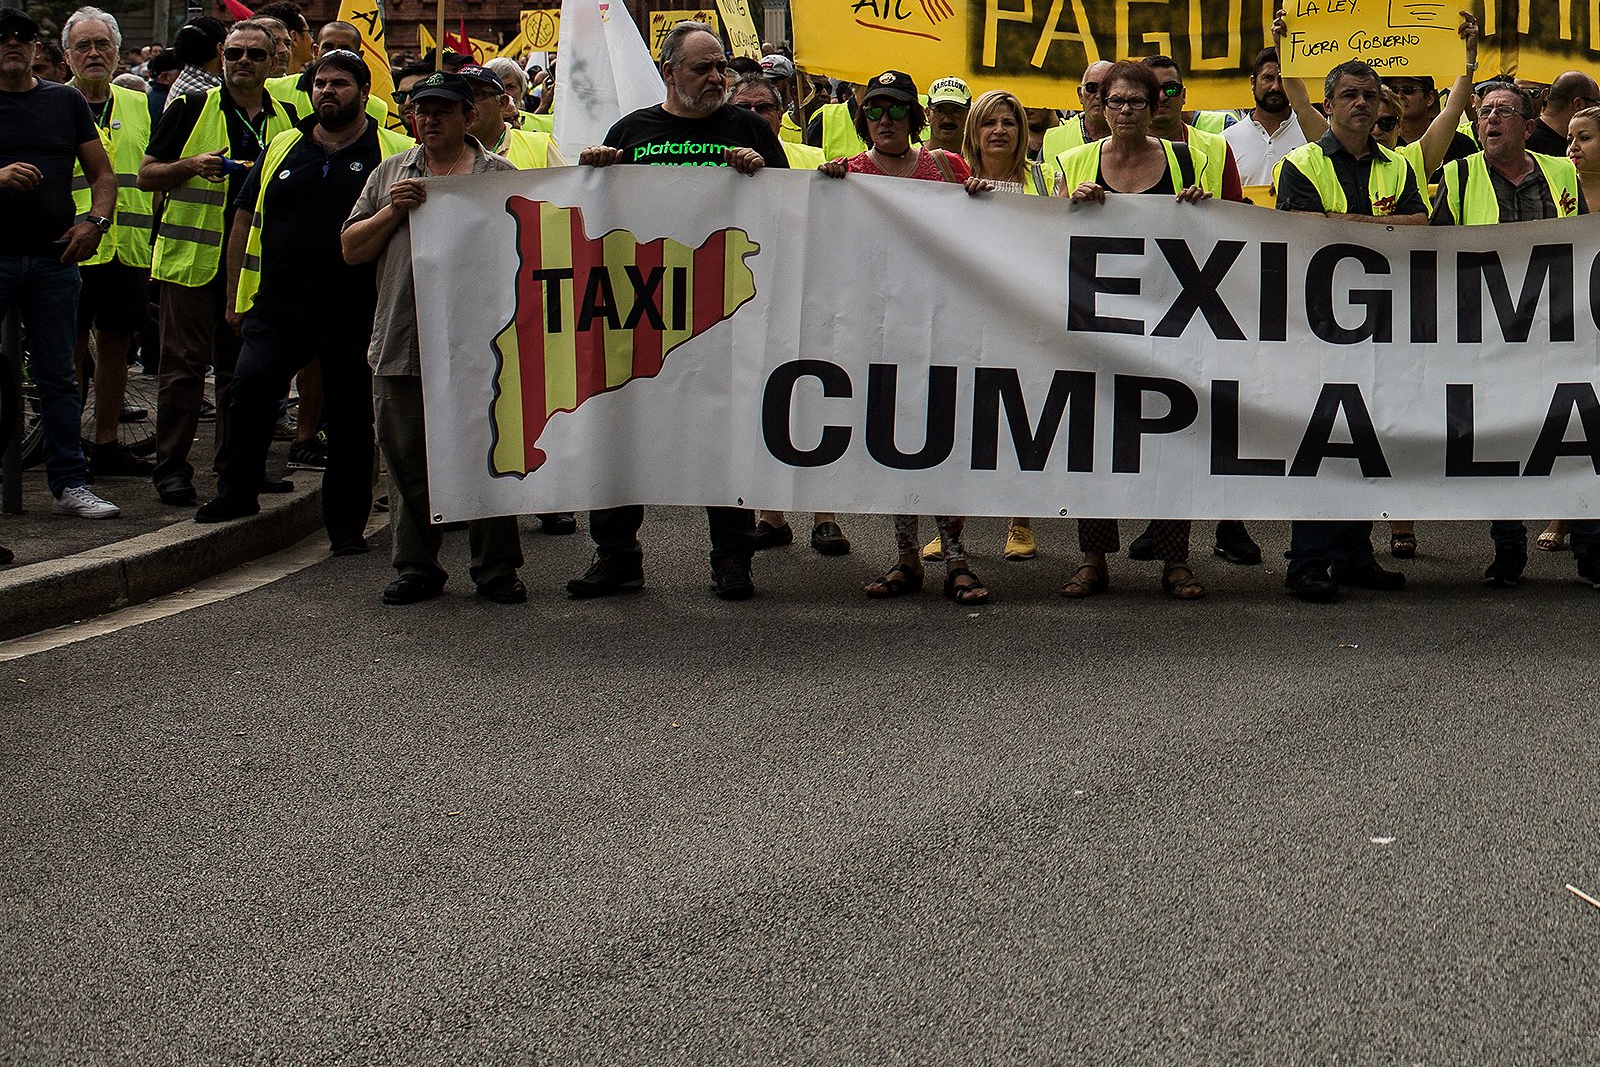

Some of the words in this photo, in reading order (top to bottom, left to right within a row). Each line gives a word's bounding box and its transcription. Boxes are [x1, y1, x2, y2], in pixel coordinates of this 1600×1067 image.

[1296, 0, 1320, 17] LA
[1291, 32, 1339, 62] FUERA
[1348, 30, 1420, 53] GOBIERNO
[532, 266, 687, 334] TAXI
[762, 359, 1392, 478] CUMPLA
